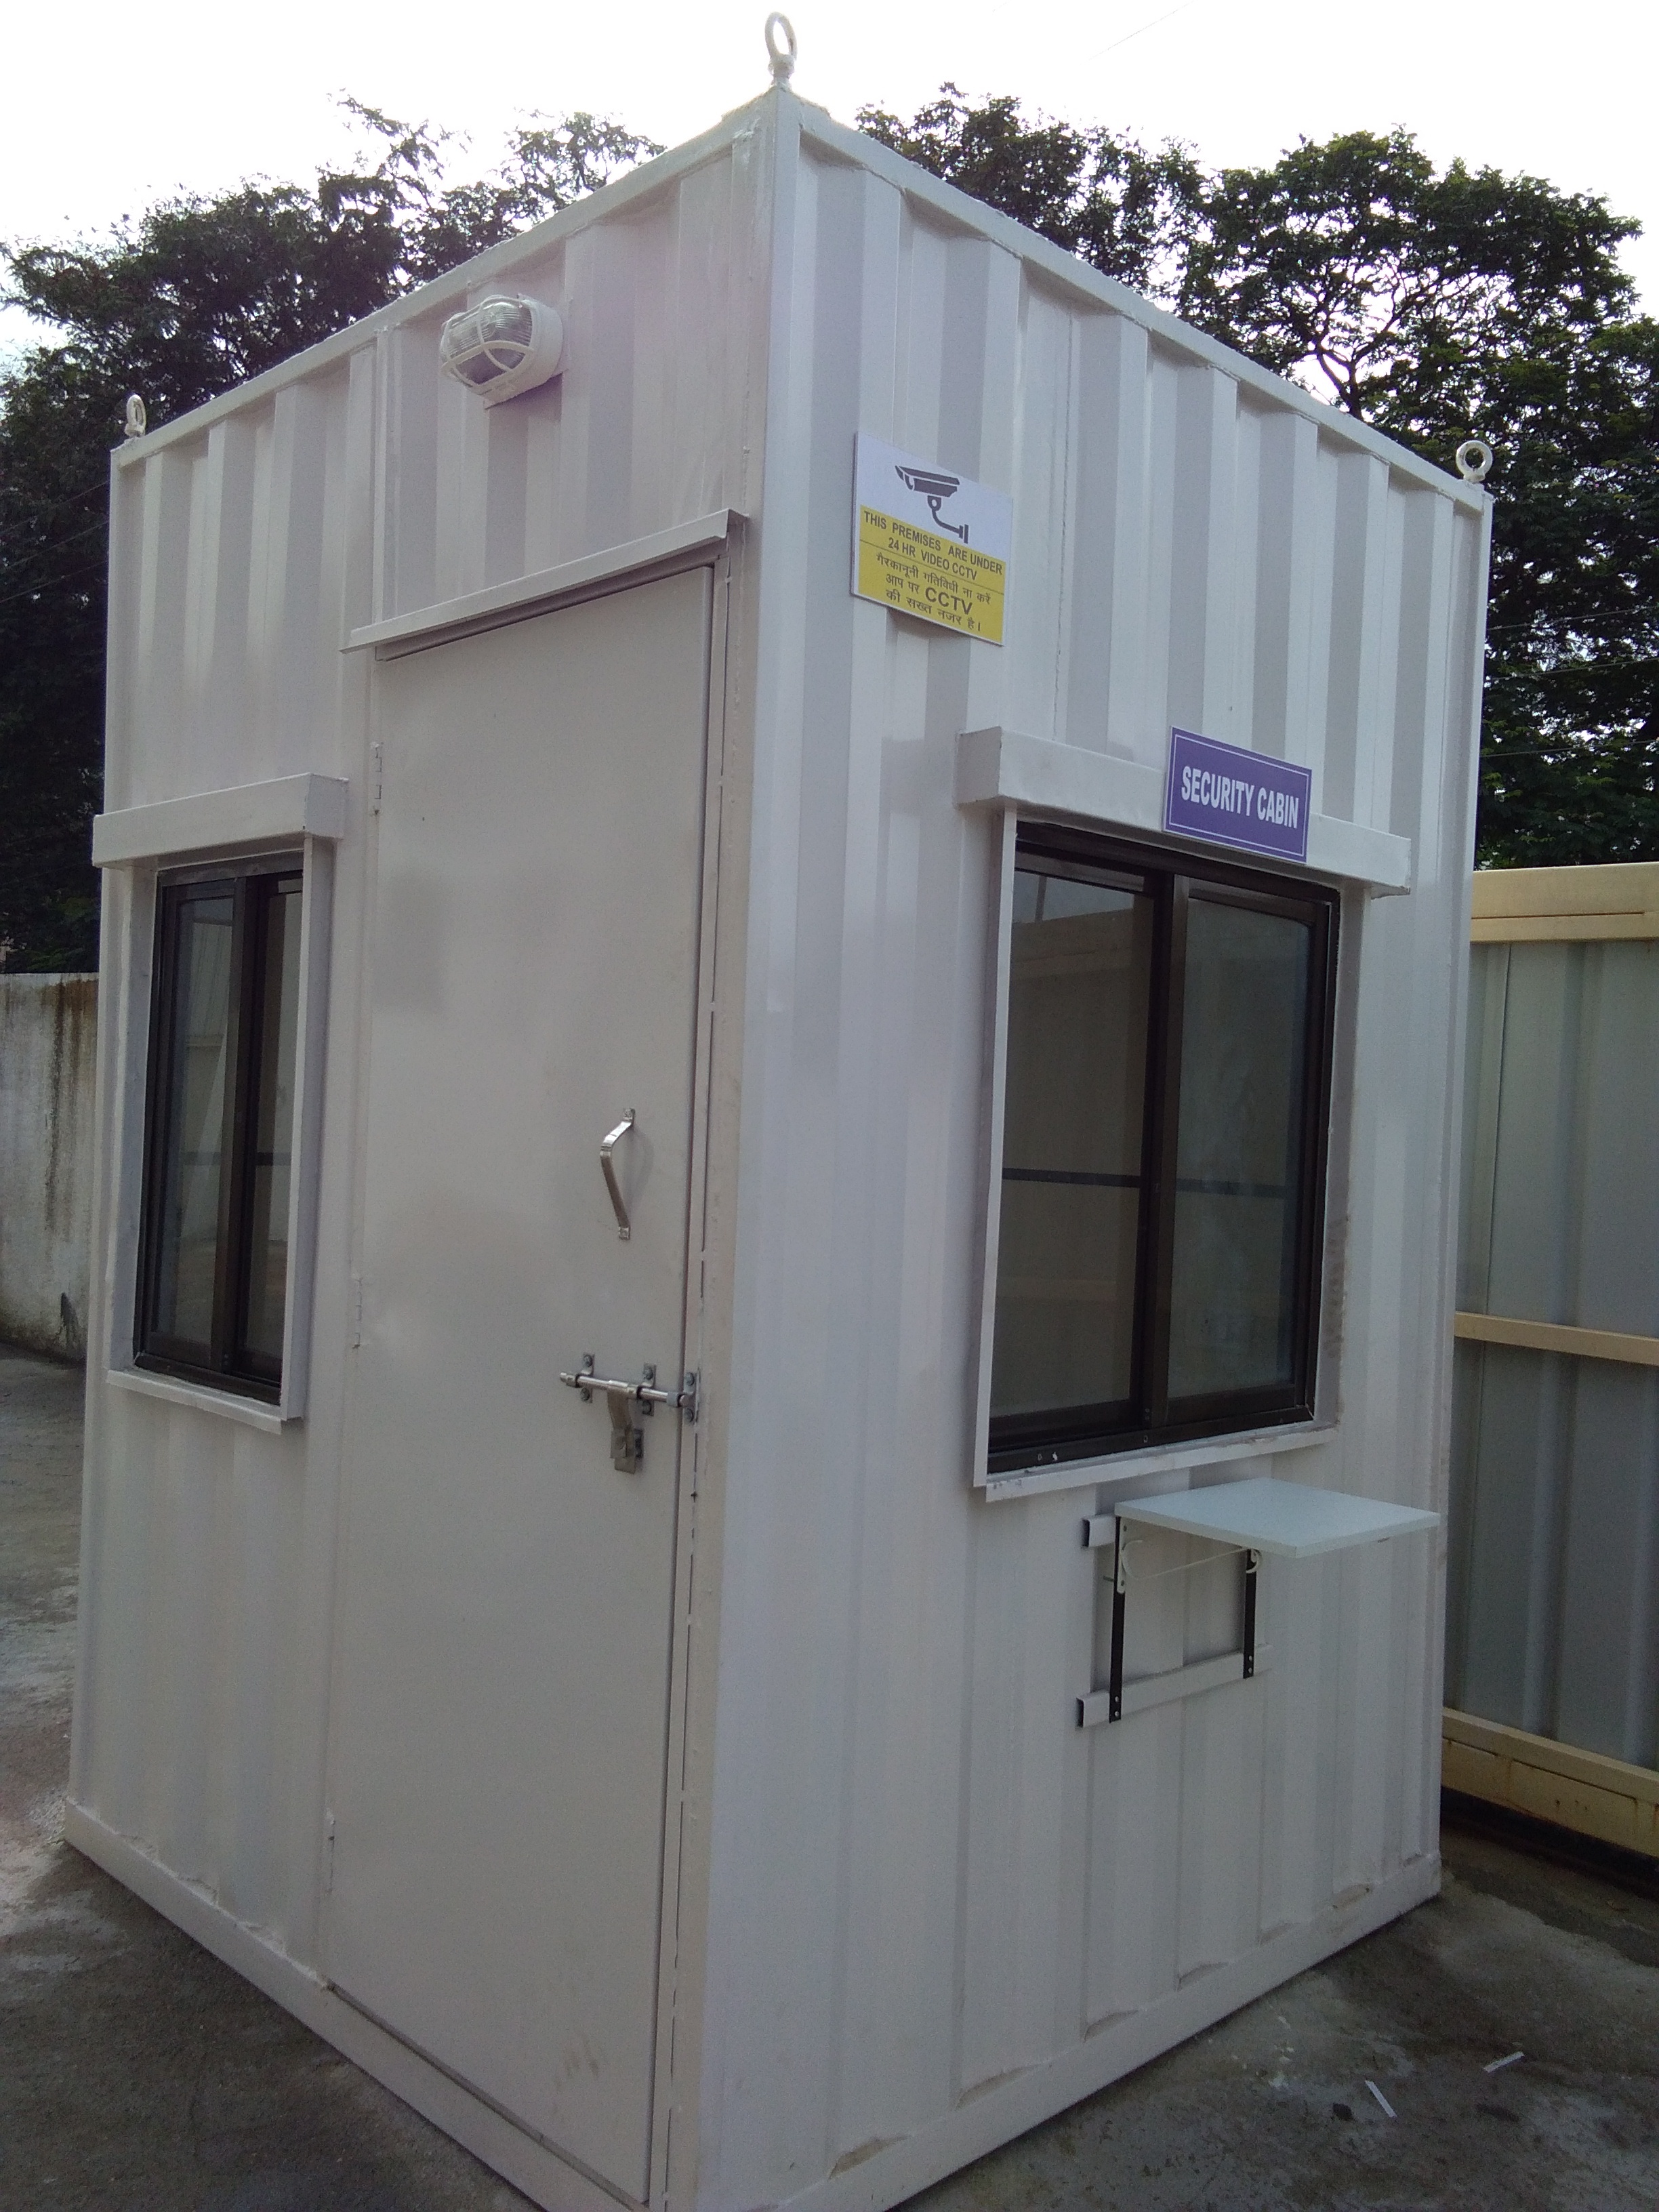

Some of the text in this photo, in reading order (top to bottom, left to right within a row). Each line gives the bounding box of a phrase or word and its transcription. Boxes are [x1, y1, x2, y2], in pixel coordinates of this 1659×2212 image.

[865, 511, 1002, 575] THIS PREMISES ARE UNDER
[888, 537, 977, 581] 24 HR VIDEO CCTV
[876, 552, 918, 579] गैरकानूनी
[962, 585, 972, 597] ना
[977, 591, 990, 604] करें
[886, 573, 972, 615] आप पर CCTV
[886, 589, 900, 602] की
[906, 597, 932, 614] सख्त
[938, 610, 962, 625] नजर
[1181, 766, 1299, 829] SECURITY CABIN
